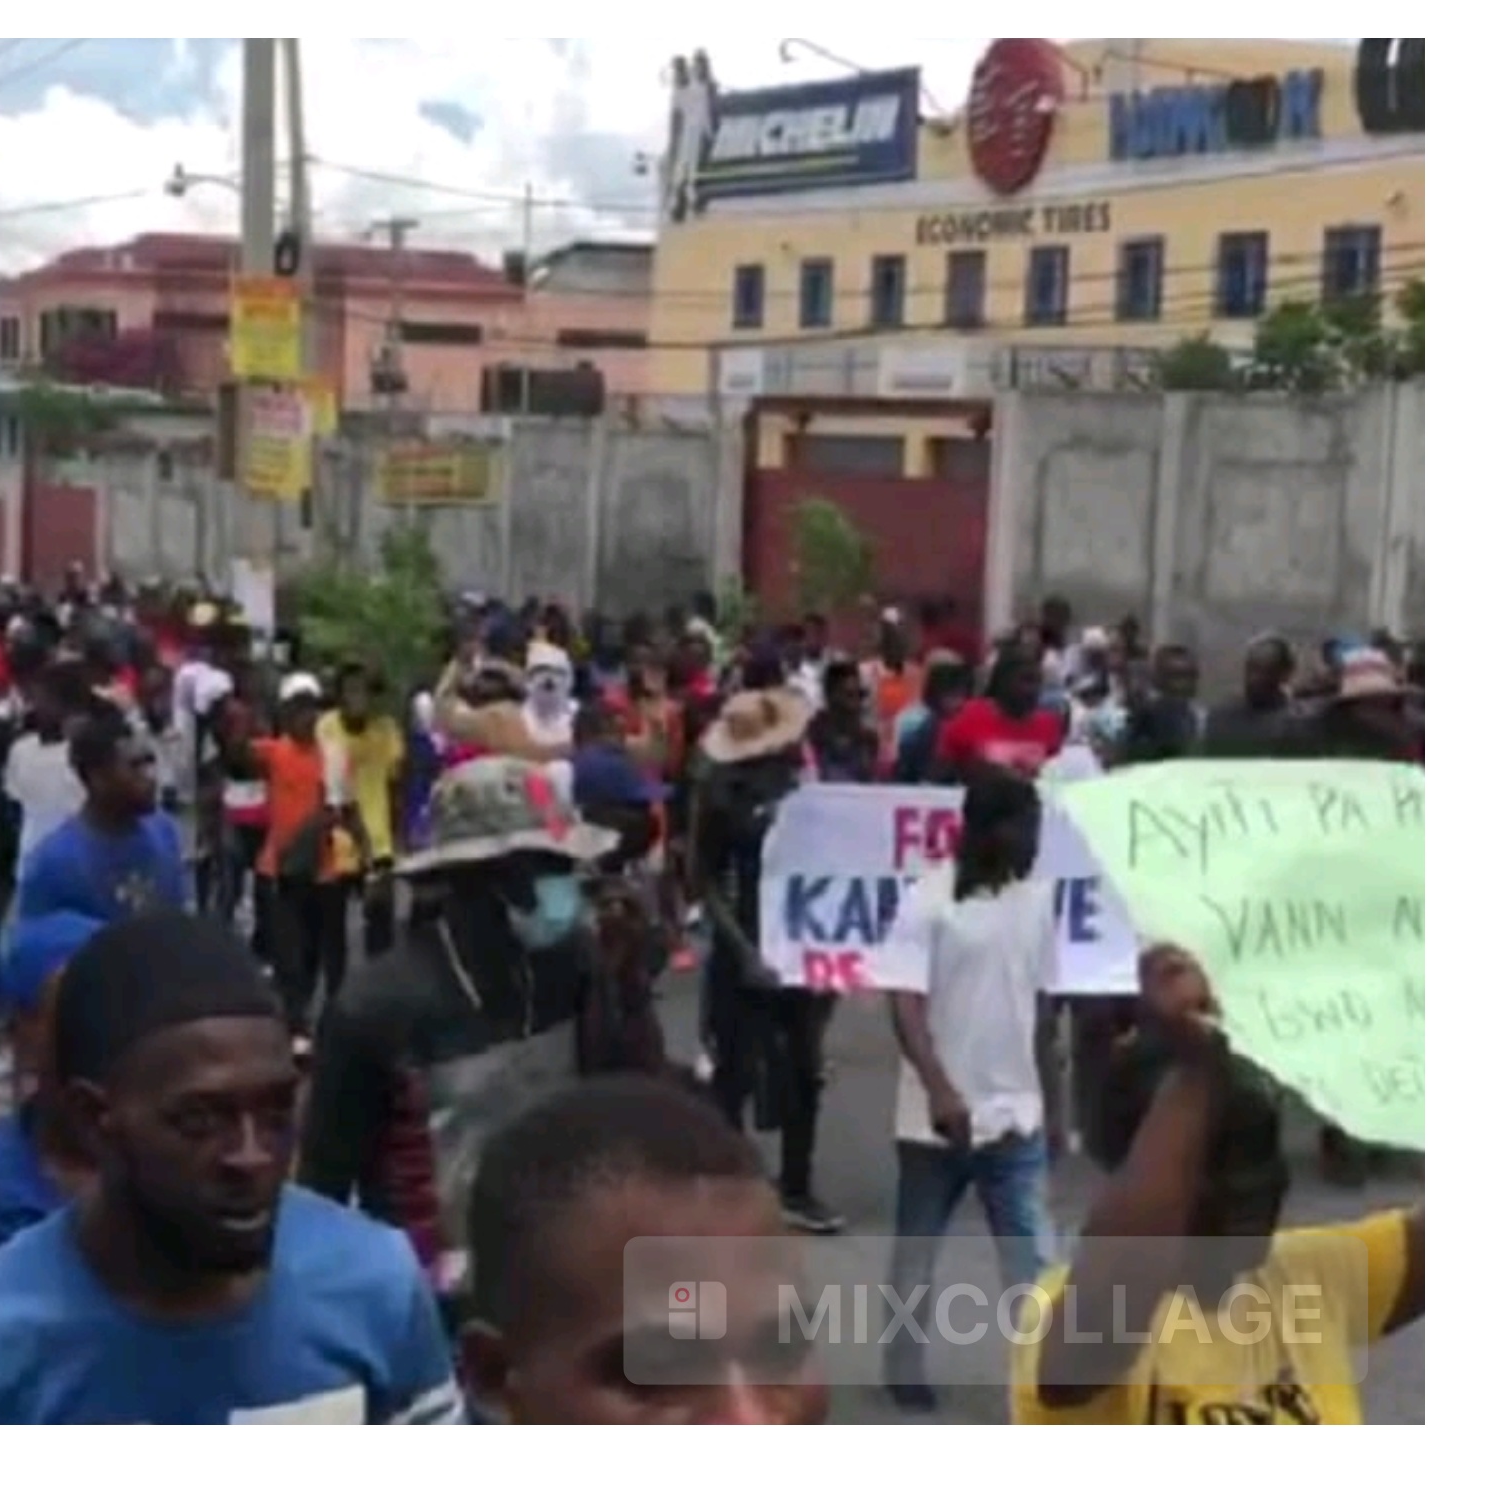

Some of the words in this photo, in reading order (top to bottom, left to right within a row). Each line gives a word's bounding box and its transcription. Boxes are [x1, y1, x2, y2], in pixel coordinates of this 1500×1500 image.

[709, 94, 900, 164] MICHELIN
[916, 205, 1034, 246] ECONOMIC
[1042, 202, 1111, 235] TIRES
[1199, 894, 1348, 960] VANN
